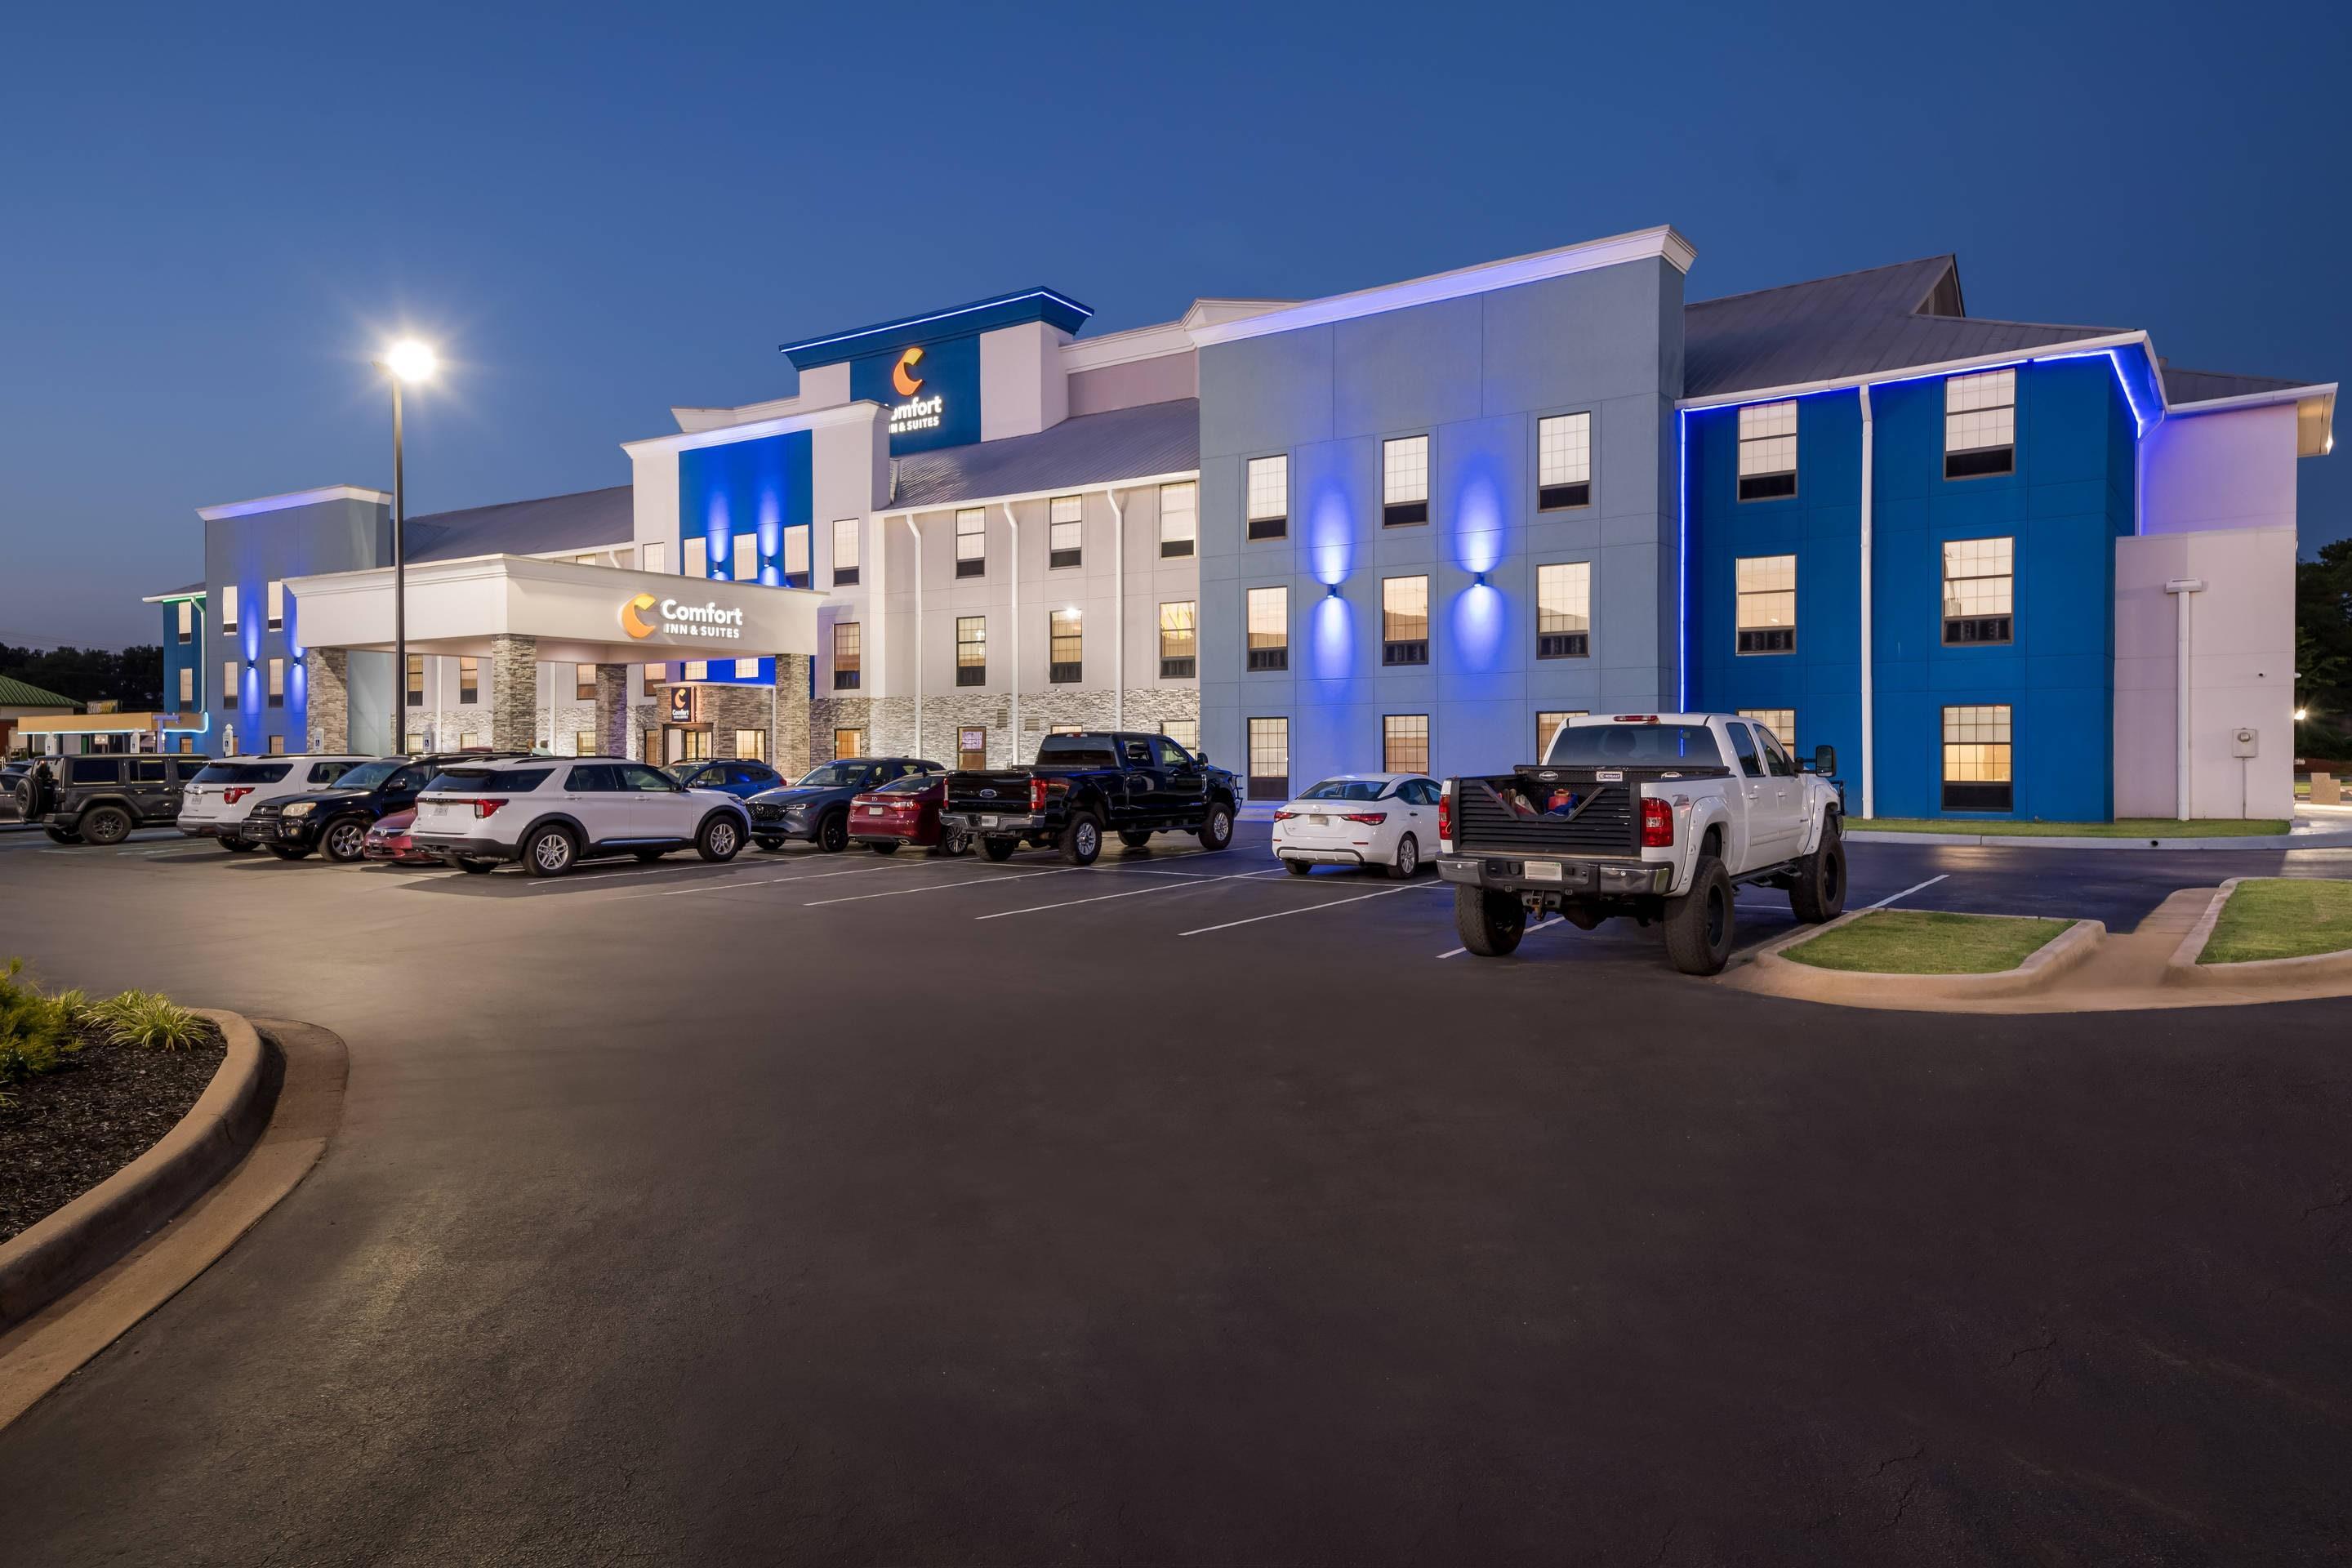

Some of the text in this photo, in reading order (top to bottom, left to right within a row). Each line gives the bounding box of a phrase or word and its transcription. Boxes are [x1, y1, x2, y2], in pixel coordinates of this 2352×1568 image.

[889, 395, 942, 421] omfort
[898, 421, 906, 432] &
[906, 416, 940, 431] SUITES
[661, 599, 743, 626] Comfort
[664, 623, 740, 639] INN & SUITES
